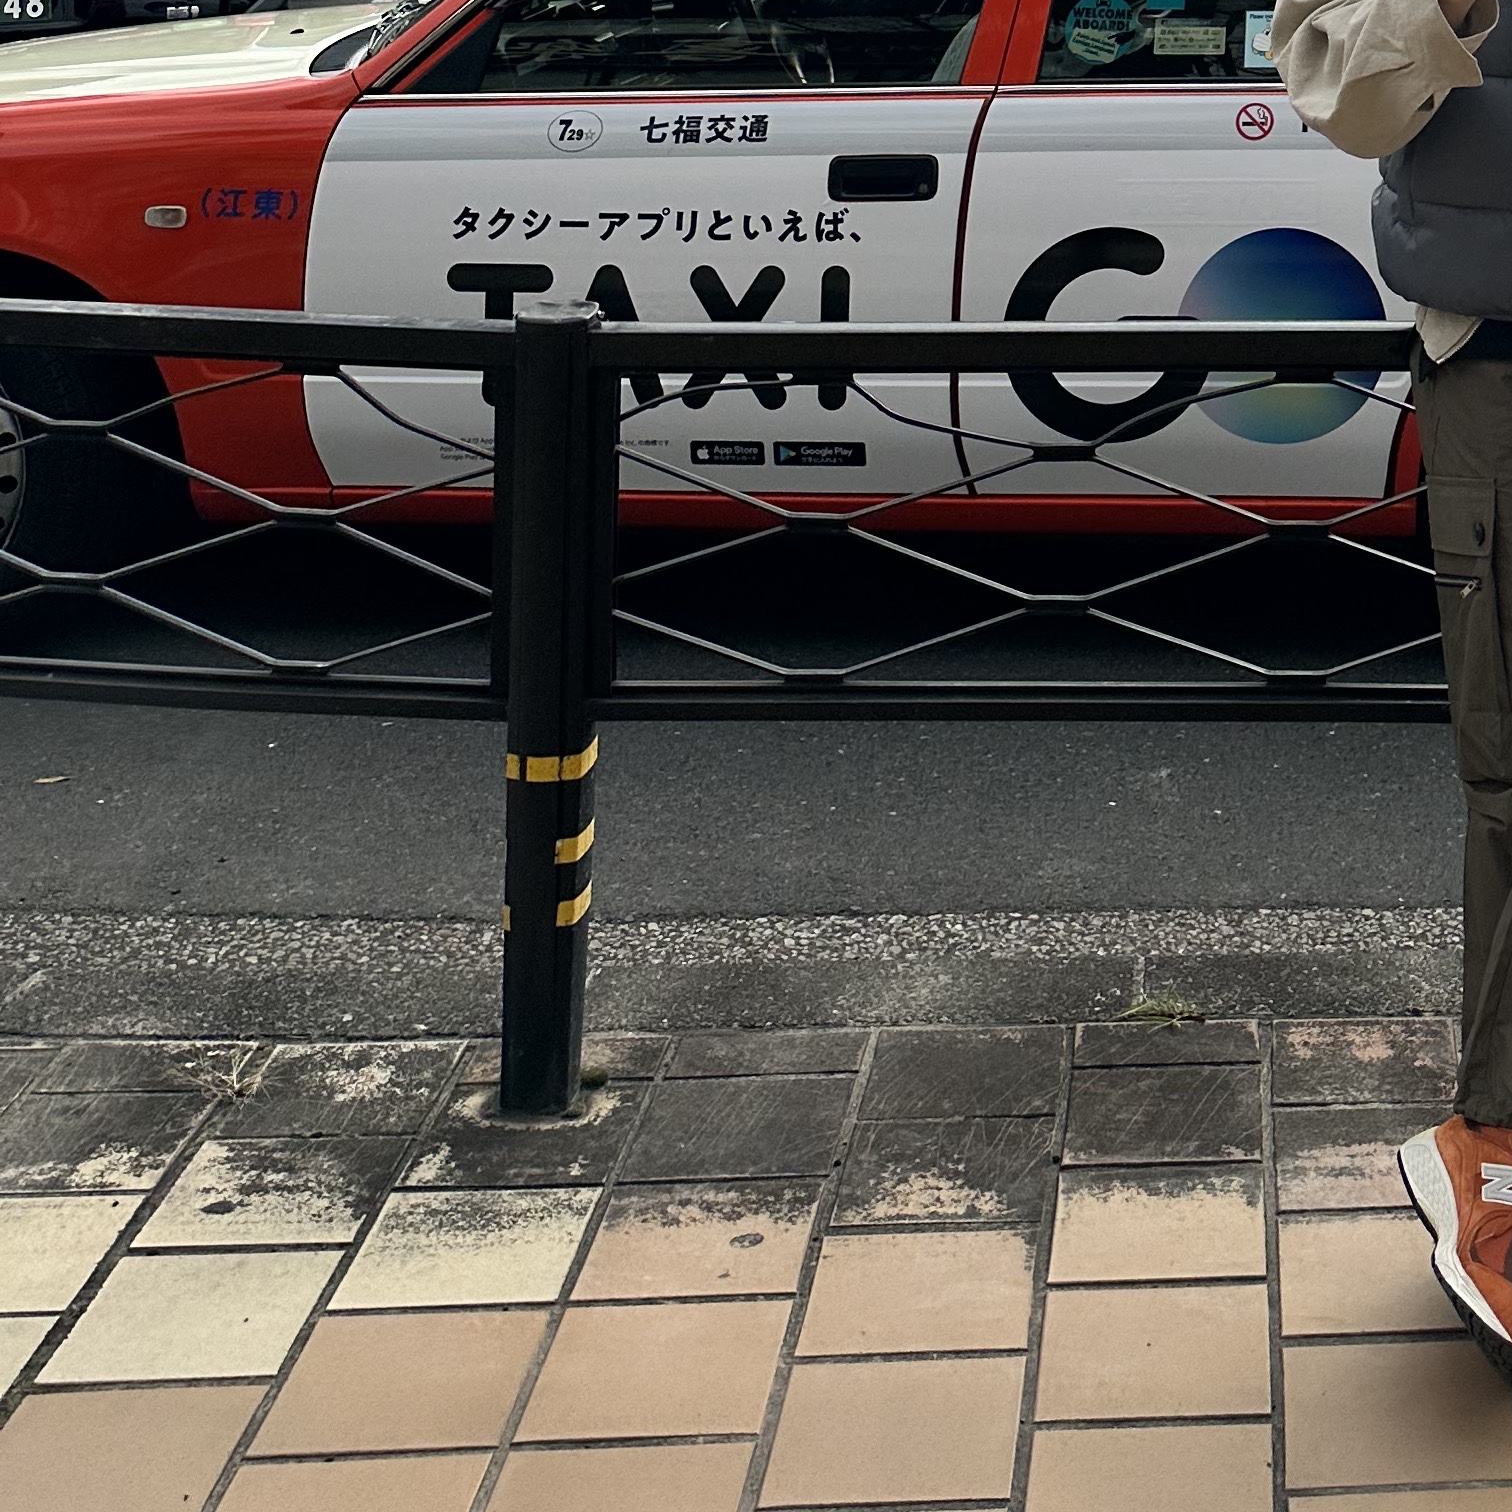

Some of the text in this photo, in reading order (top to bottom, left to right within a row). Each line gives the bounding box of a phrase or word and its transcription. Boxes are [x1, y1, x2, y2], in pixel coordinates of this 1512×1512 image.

[1073, 7, 1133, 20] WELCOME
[1072, 19, 1130, 31] ABOARD!
[639, 114, 770, 145] 七福交通
[452, 206, 864, 243] タクシーアプリといえば、
[447, 226, 1388, 445] TAXI GO
[713, 445, 759, 455] App Store
[800, 446, 853, 457] Google Play
